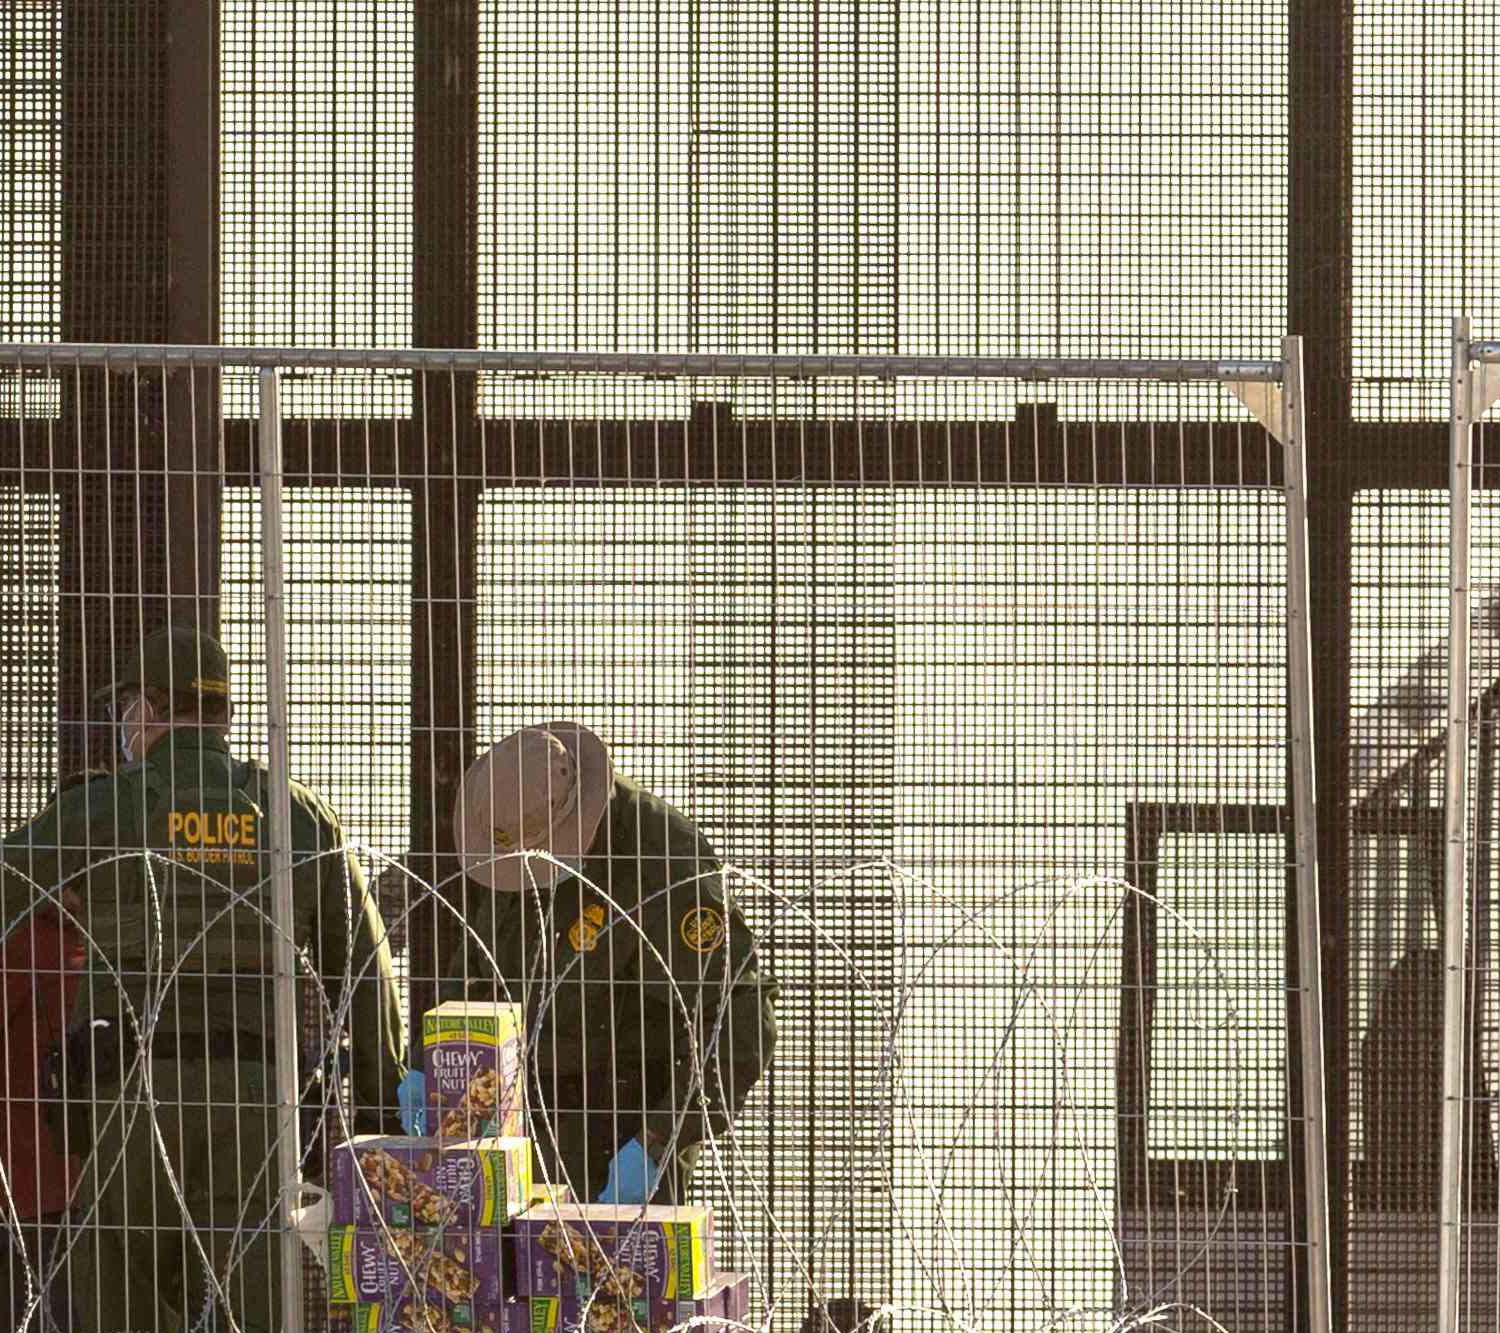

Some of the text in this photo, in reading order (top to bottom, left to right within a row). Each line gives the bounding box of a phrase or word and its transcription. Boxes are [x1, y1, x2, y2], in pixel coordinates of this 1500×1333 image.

[168, 812, 256, 845] POLICE
[186, 849, 222, 864] BORDER
[432, 1048, 484, 1068] CHEWY
[434, 1066, 463, 1079] FRUIT
[440, 1078, 466, 1090] NUT
[435, 1165, 447, 1190] NUT
[447, 1158, 457, 1190] FRUIT
[456, 1157, 476, 1211] CHEWY
[360, 1241, 378, 1295] CHEWY
[643, 1230, 660, 1283] CHEWY
[679, 1224, 691, 1297] NATURE VALLEY
[387, 1258, 400, 1286] NUT
